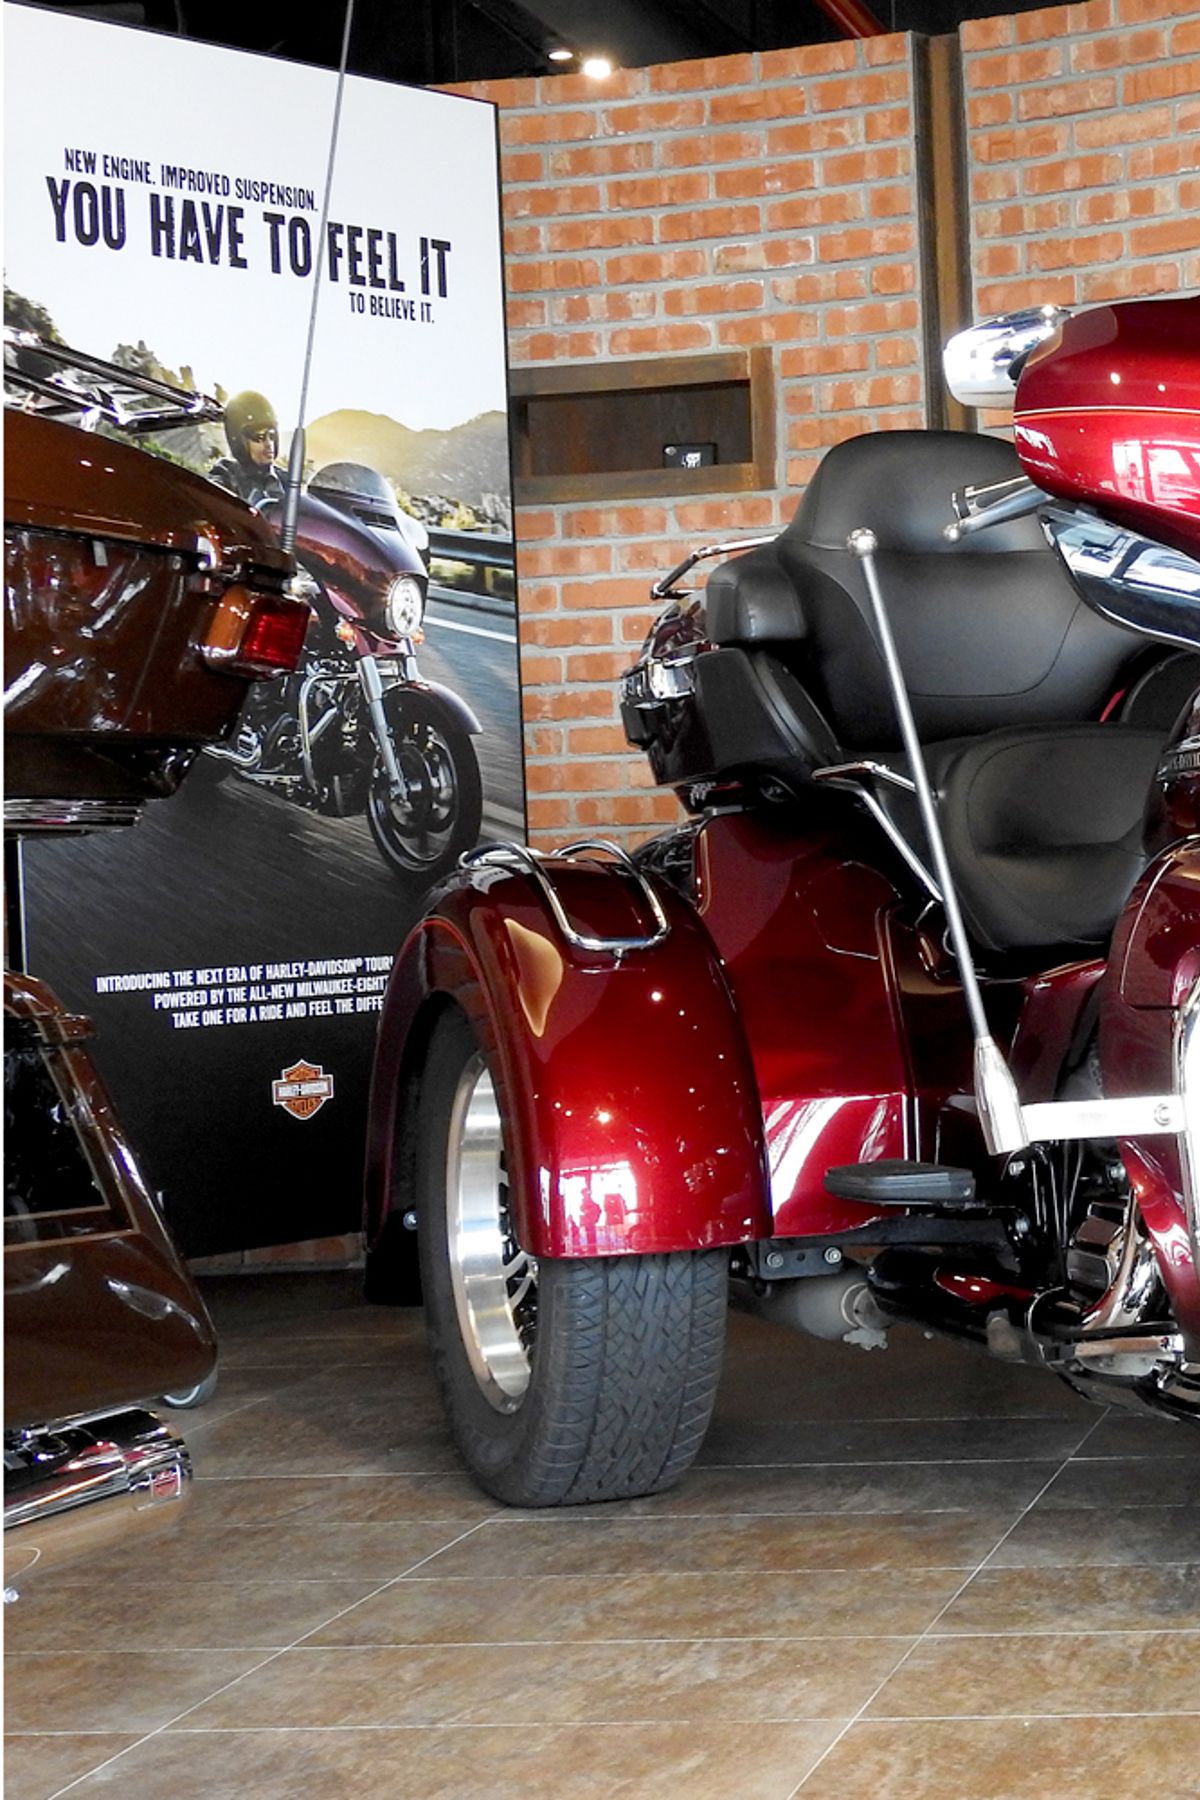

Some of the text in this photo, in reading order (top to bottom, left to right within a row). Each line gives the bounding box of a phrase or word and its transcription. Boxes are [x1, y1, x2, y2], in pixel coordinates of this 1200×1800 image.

[65, 149, 317, 211] NEW ENGINE. IMPROVED SUSPENSION.
[46, 176, 451, 298] YOU HAVE TO FEEL IT
[349, 292, 434, 322] TO BELIEVE IT.
[97, 972, 171, 992] INTRODUCING
[172, 970, 194, 986] THE
[196, 968, 223, 985] NEXT
[226, 967, 247, 983] ERA
[250, 965, 263, 981] OF
[154, 990, 207, 1009] POWERED
[210, 988, 224, 1004] BY
[227, 987, 247, 1003] THE
[249, 983, 294, 1001] ALL-NEW
[172, 1011, 200, 1028] TAKE
[202, 1009, 223, 1026] ONE
[226, 1007, 247, 1023] FOR
[250, 1006, 257, 1021] A
[259, 1004, 283, 1020] RIDE
[286, 1002, 306, 1018] AND
[309, 1000, 333, 1016] FEEL
[335, 998, 354, 1013] THE
